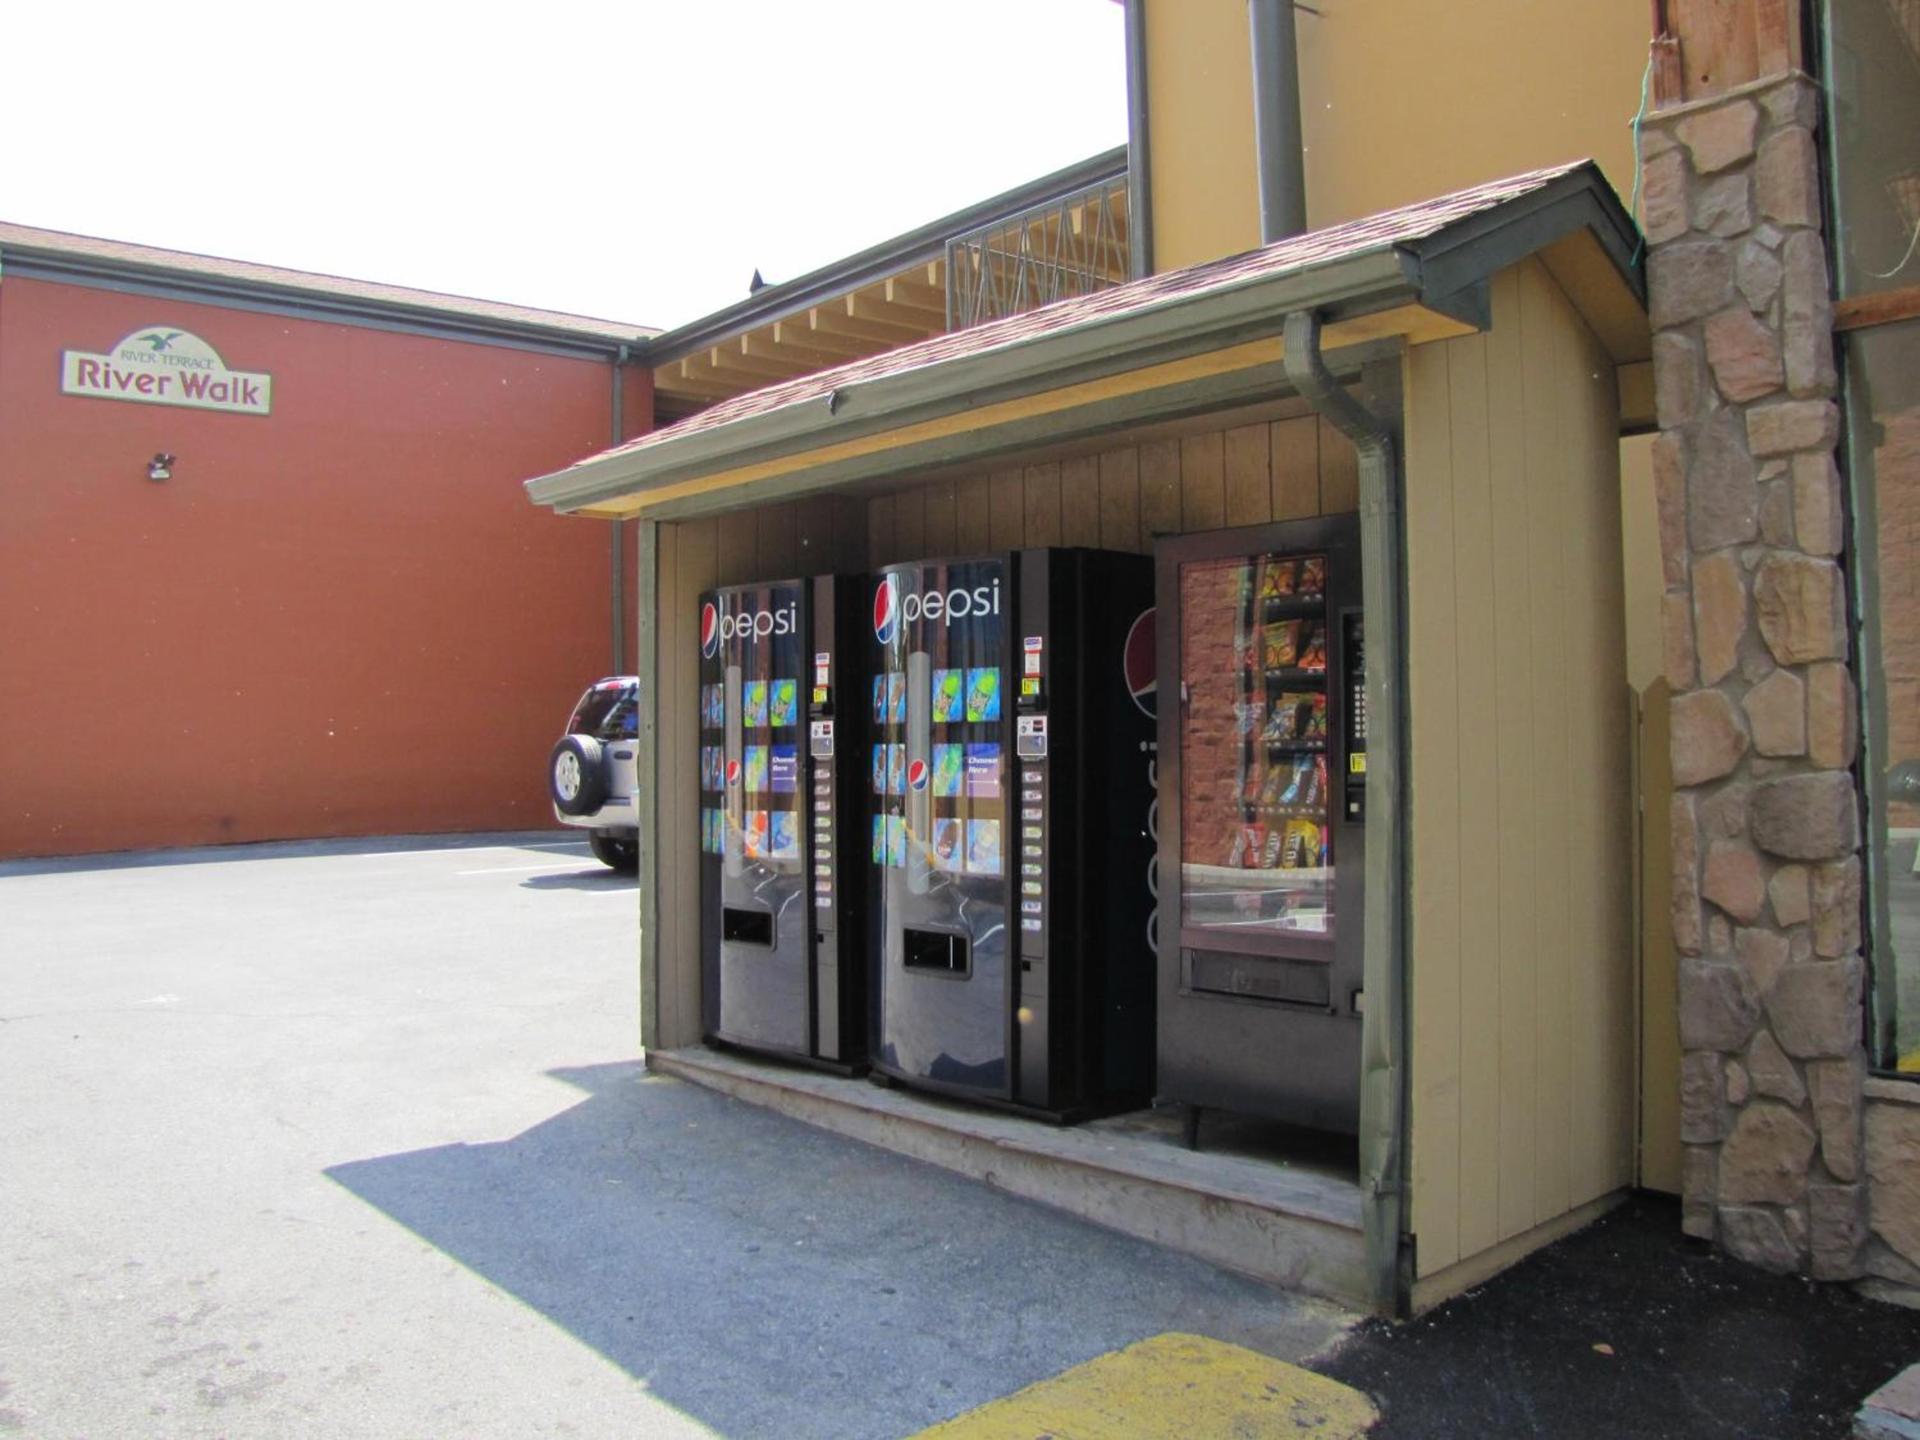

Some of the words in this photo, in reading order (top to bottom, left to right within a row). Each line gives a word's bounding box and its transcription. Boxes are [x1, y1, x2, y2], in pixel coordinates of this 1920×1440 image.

[78, 358, 172, 396] River
[179, 370, 260, 405] Walk
[121, 350, 156, 364] RIVER
[161, 353, 214, 370] TERRACE
[719, 601, 796, 648] pepsi
[902, 577, 1000, 632] pepsi
